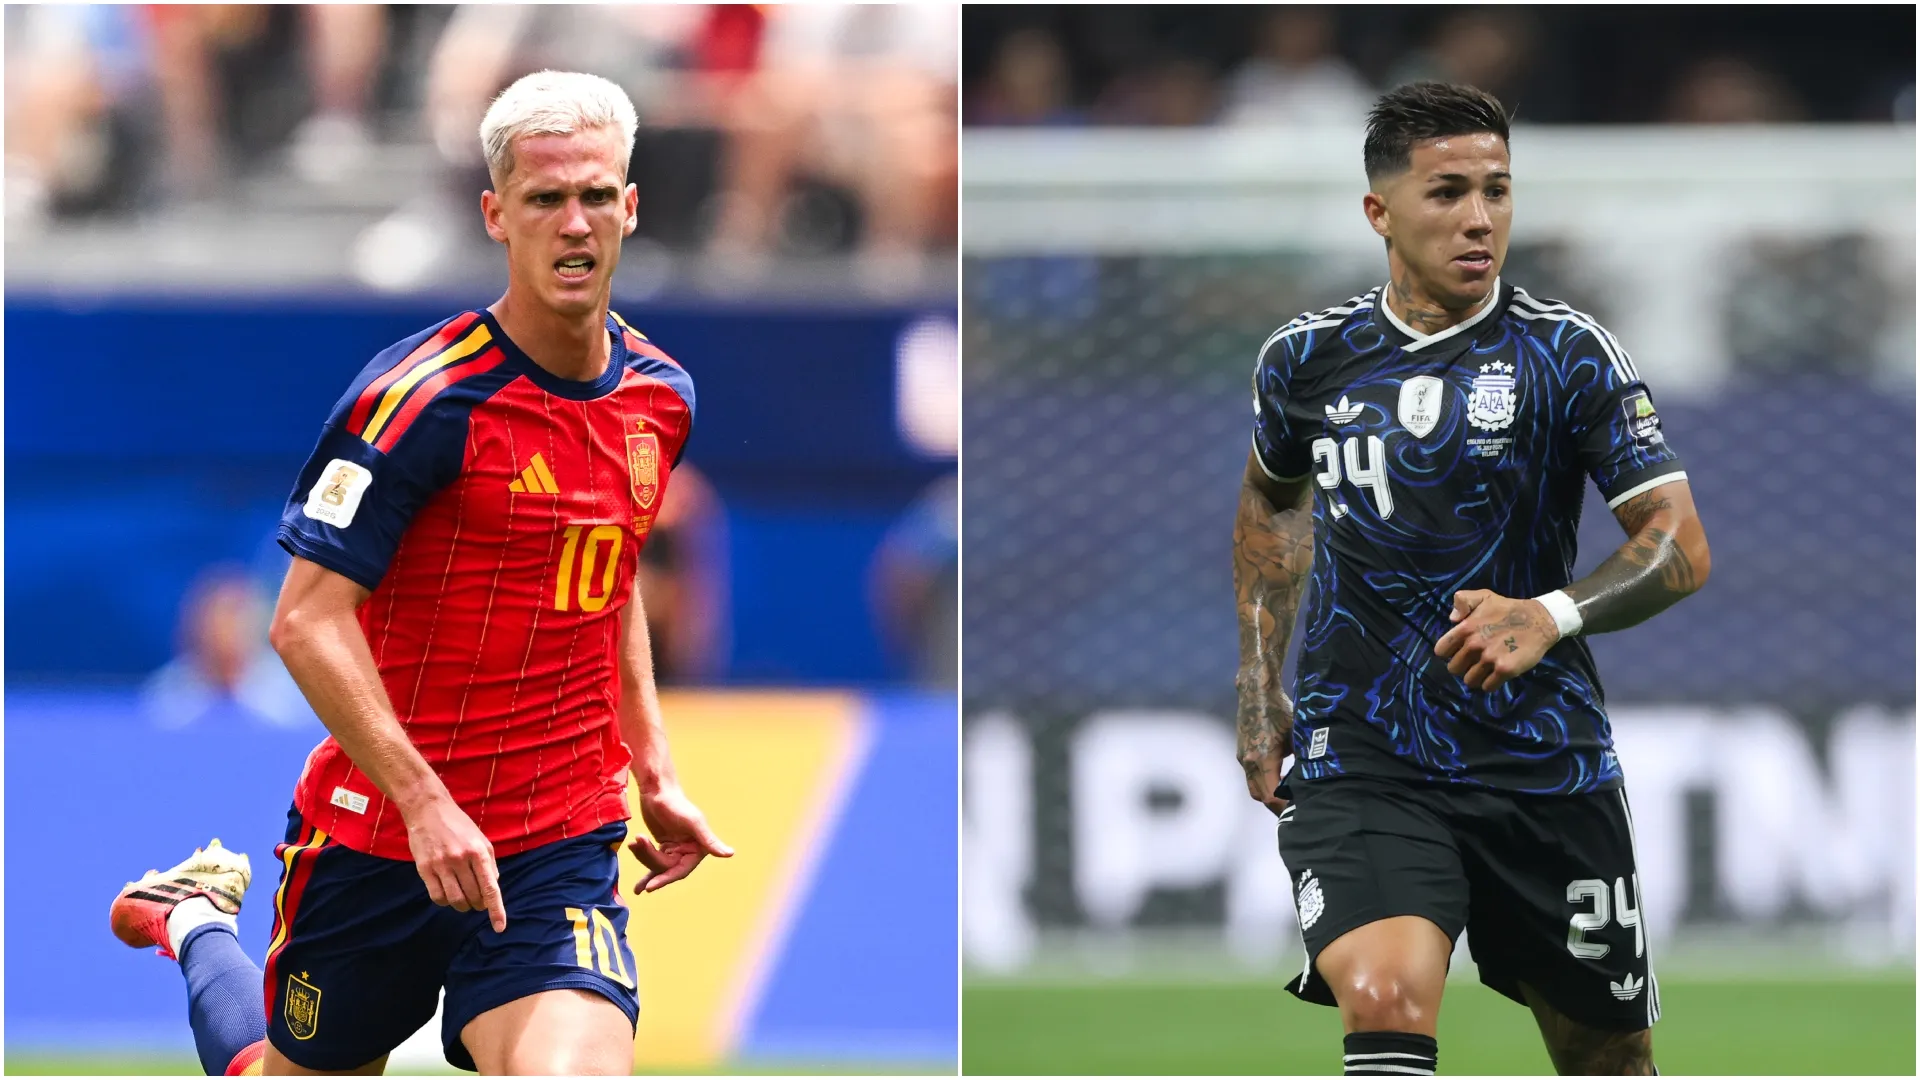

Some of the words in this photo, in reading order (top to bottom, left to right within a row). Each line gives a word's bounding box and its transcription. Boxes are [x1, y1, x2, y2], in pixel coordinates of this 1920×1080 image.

[1478, 389, 1505, 414] AFA
[316, 507, 337, 519] 2026
[1312, 435, 1395, 521] 24
[554, 525, 623, 612] 10
[564, 906, 635, 990] 10
[1566, 873, 1646, 960] 24
